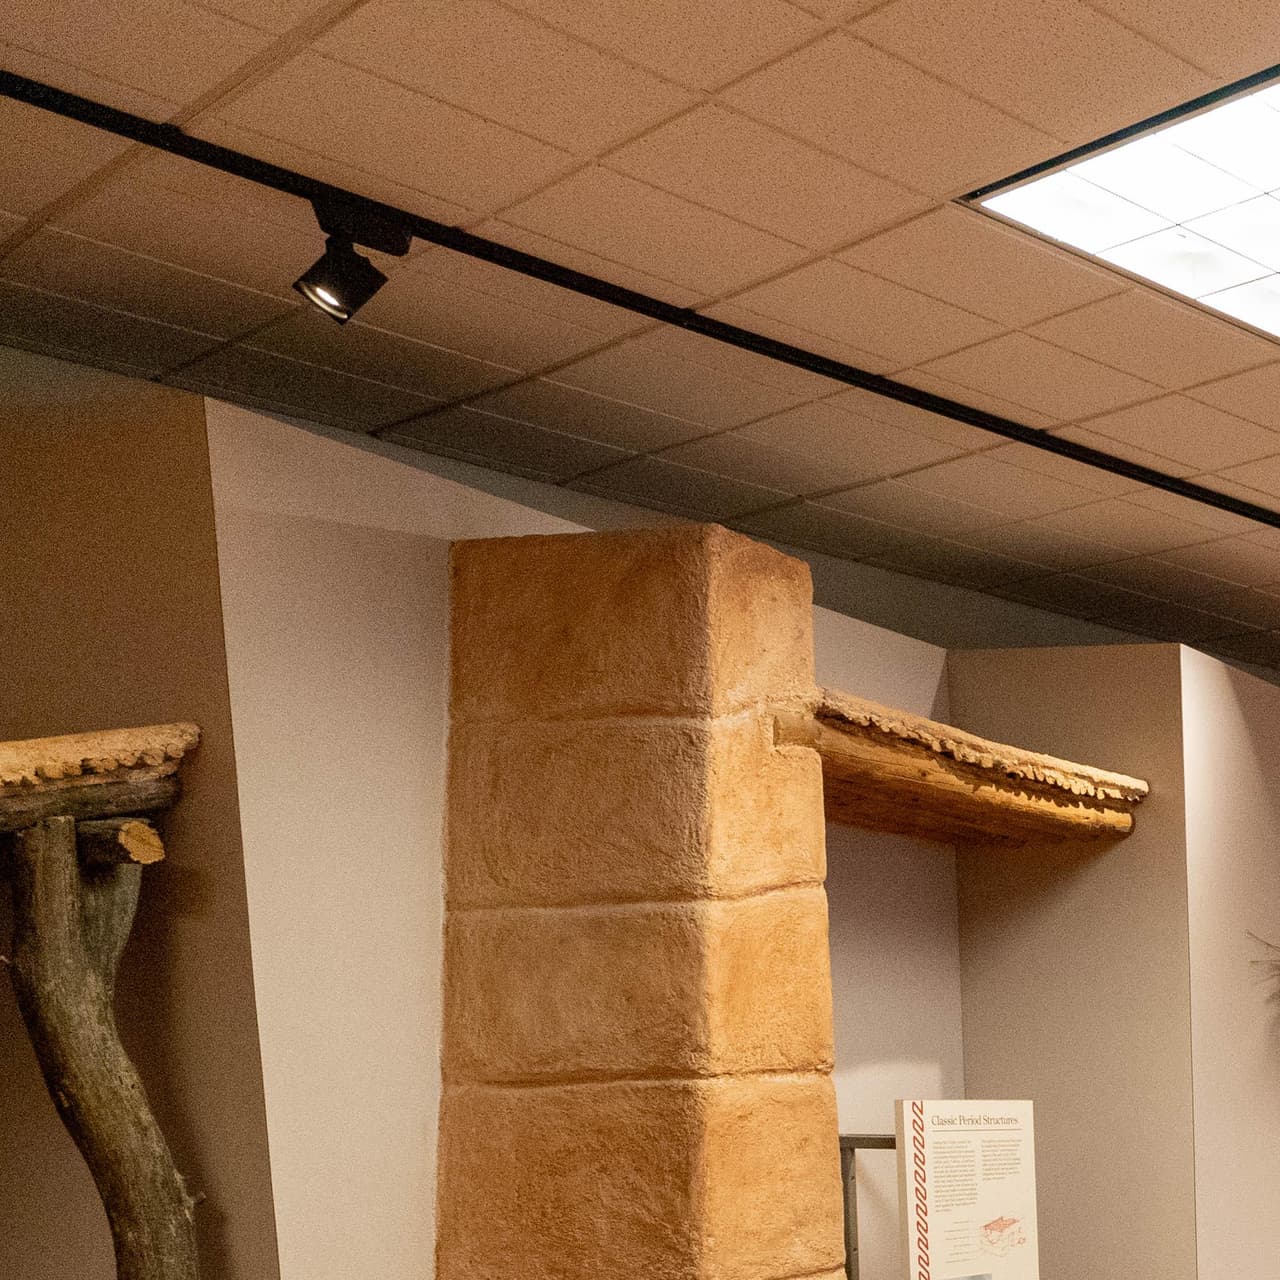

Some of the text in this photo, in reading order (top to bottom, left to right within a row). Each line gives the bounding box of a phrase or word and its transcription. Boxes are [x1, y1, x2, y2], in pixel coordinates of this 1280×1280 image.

[931, 1114, 1018, 1126] Classic Period Structures
